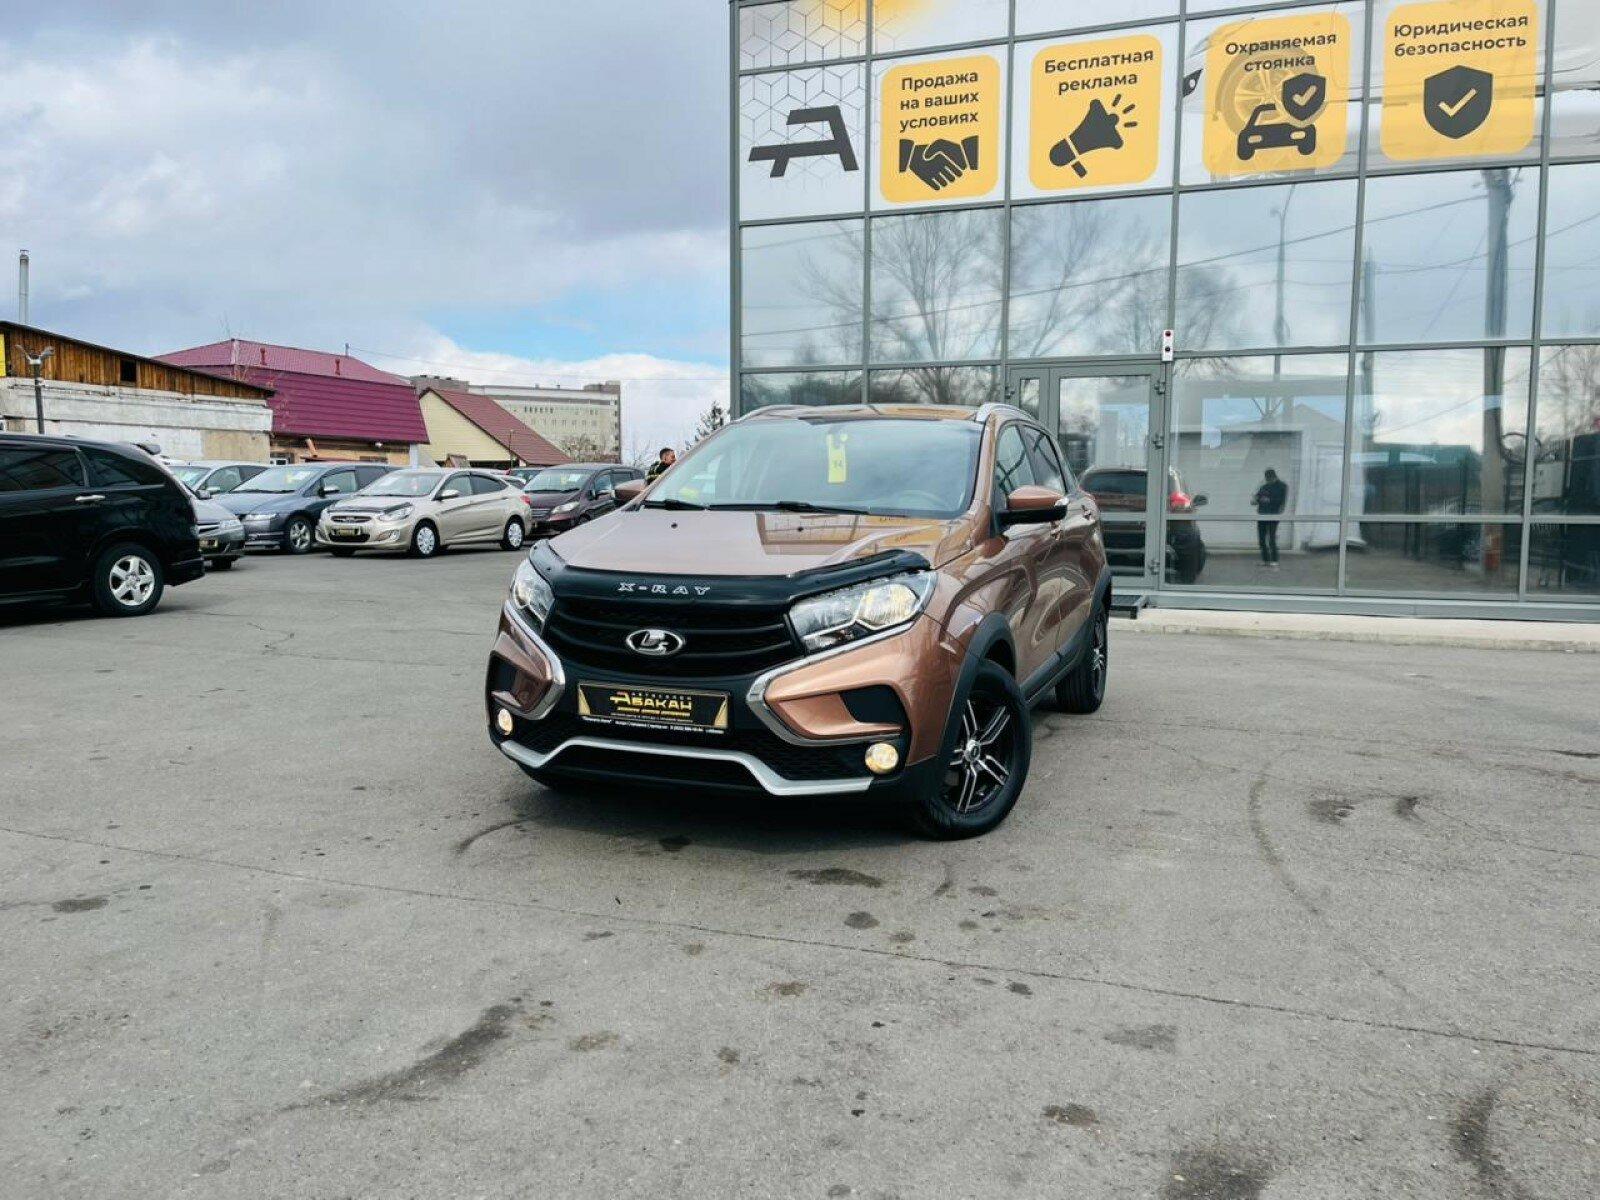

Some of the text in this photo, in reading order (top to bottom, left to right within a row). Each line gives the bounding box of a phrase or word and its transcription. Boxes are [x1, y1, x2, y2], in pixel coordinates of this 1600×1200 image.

[1394, 15, 1529, 39] Юридическая
[1225, 33, 1337, 56] Охраняемая
[1394, 35, 1527, 58] безопасность
[1045, 49, 1154, 75] Бесплатная
[1244, 55, 1316, 72] стоянка
[901, 69, 979, 91] Продажа
[1058, 72, 1139, 96] реклама
[900, 91, 979, 111] на ваших
[900, 110, 979, 133] условиях
[617, 582, 711, 596] X-RAY
